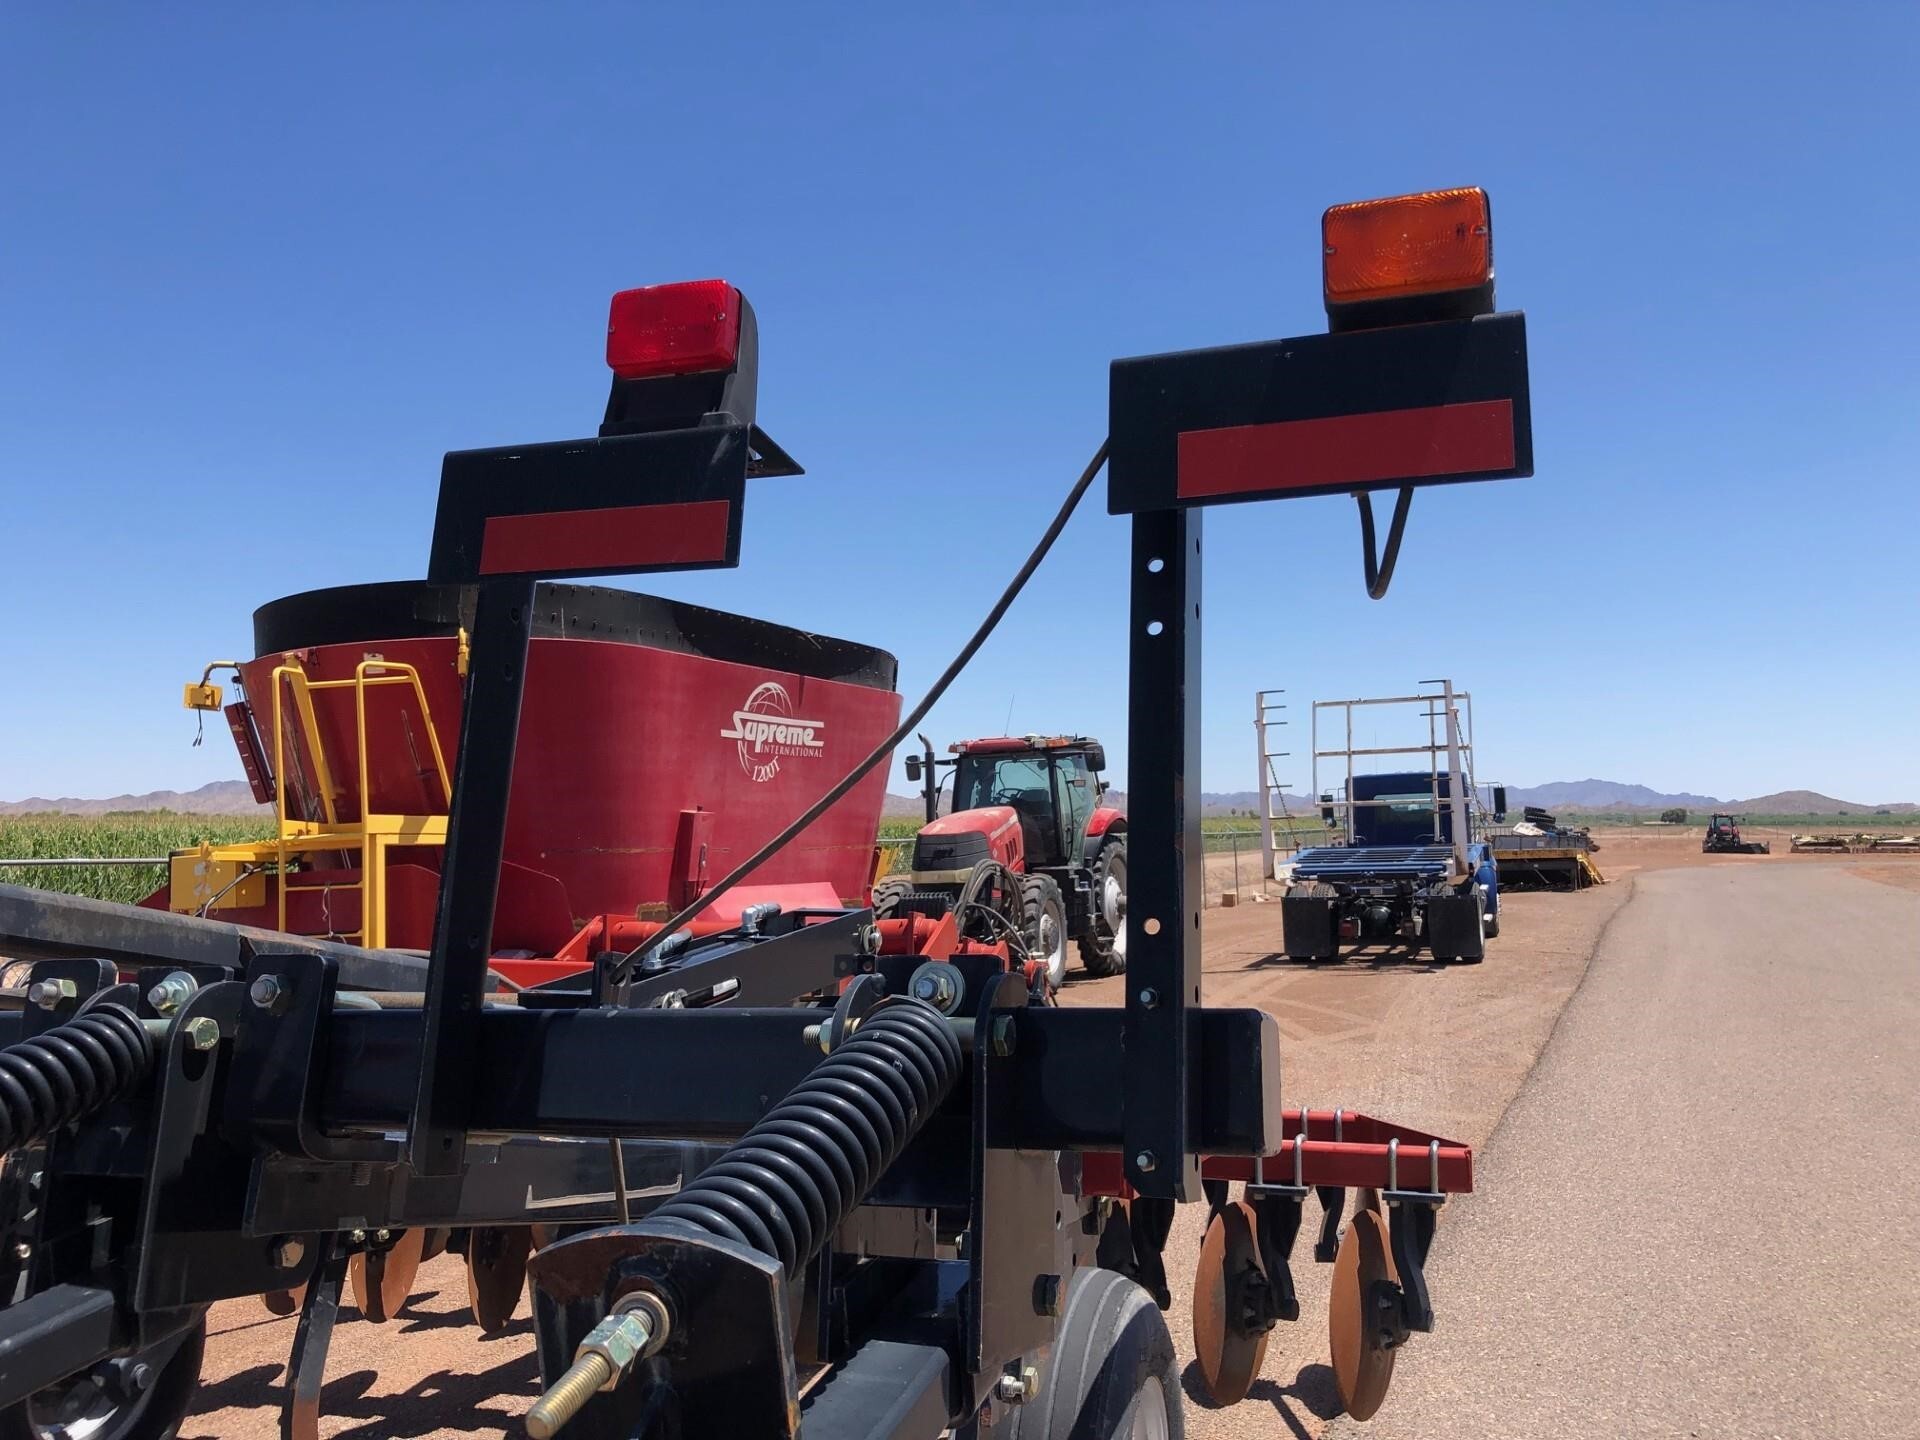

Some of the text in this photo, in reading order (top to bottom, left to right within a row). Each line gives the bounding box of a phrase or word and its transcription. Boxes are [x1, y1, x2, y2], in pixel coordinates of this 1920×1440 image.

[721, 711, 824, 753] Supreme
[761, 743, 823, 758] INTERNATIONAL
[752, 755, 780, 783] 1200T
